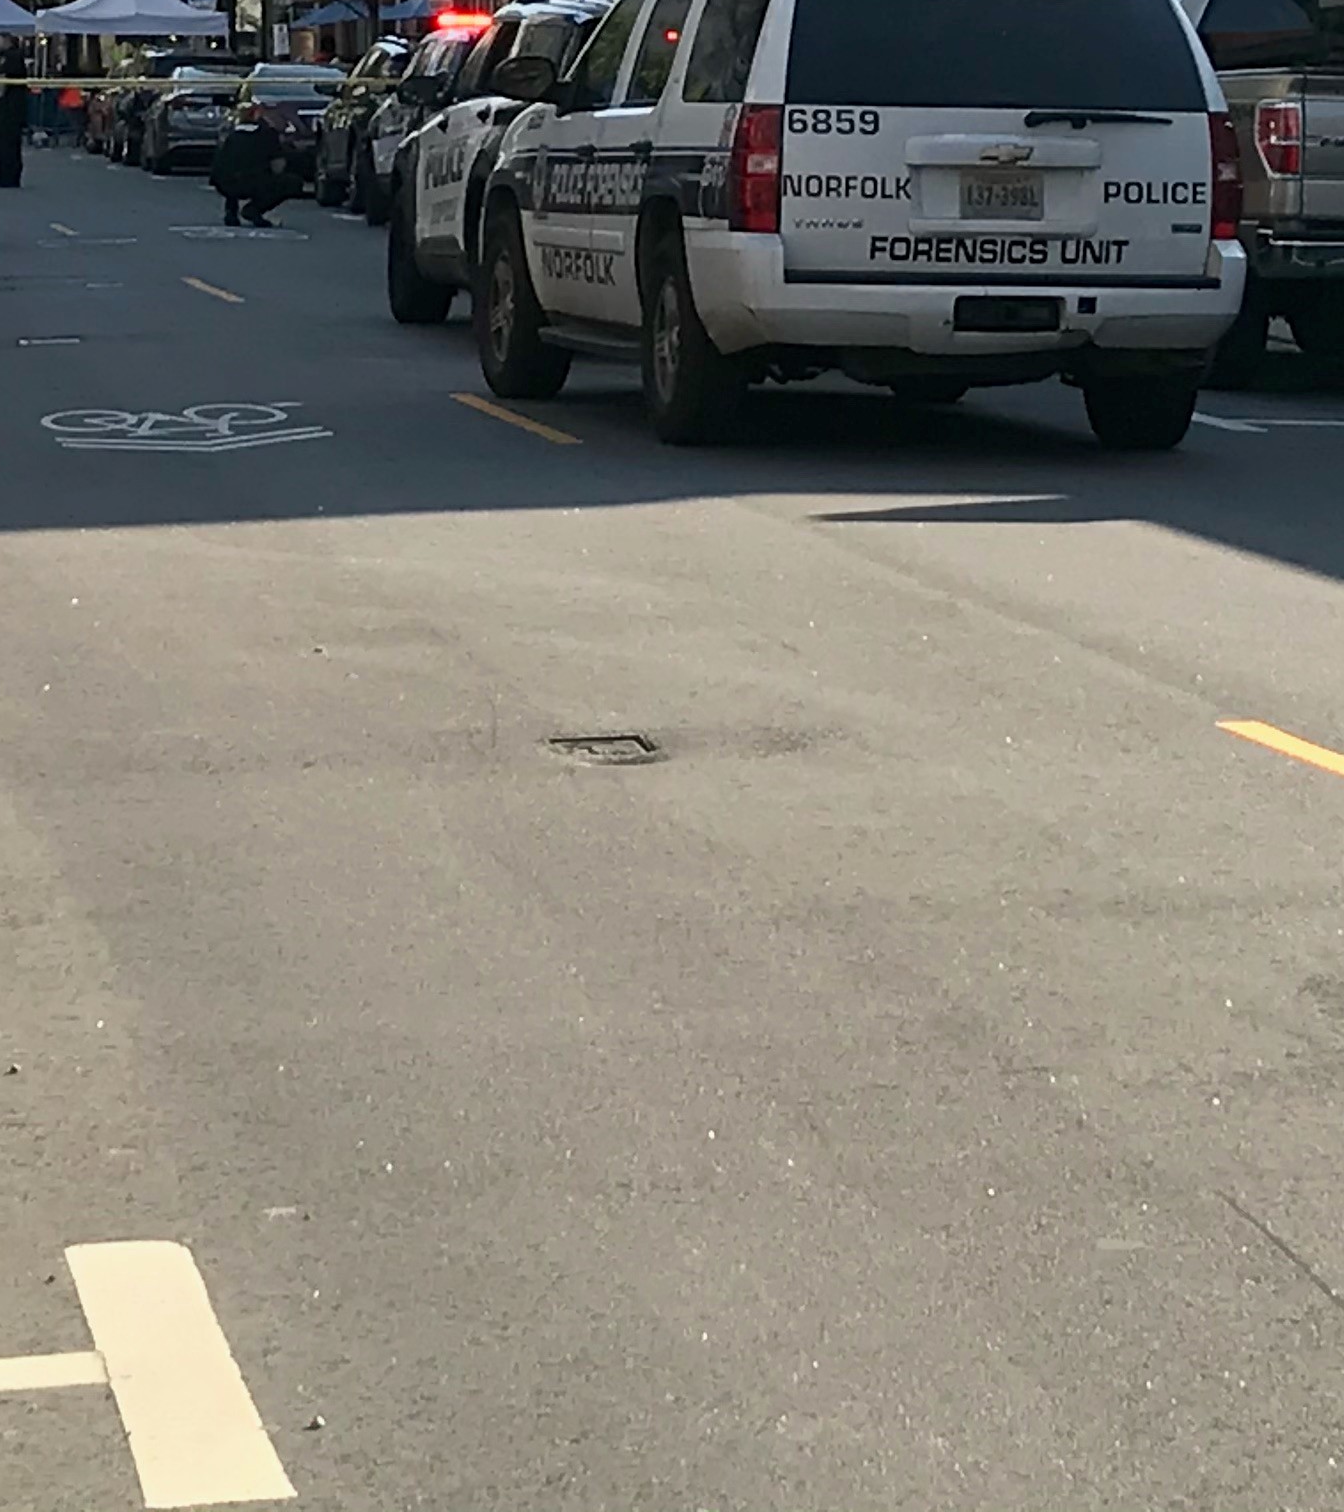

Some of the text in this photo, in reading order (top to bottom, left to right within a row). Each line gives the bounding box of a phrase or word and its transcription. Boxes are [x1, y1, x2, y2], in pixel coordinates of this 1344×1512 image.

[788, 109, 881, 135] 6859
[783, 173, 1208, 205] NORFOLK POLICE
[869, 236, 1129, 265] FORENSICS UNIT
[541, 248, 616, 286] NORFOLK
